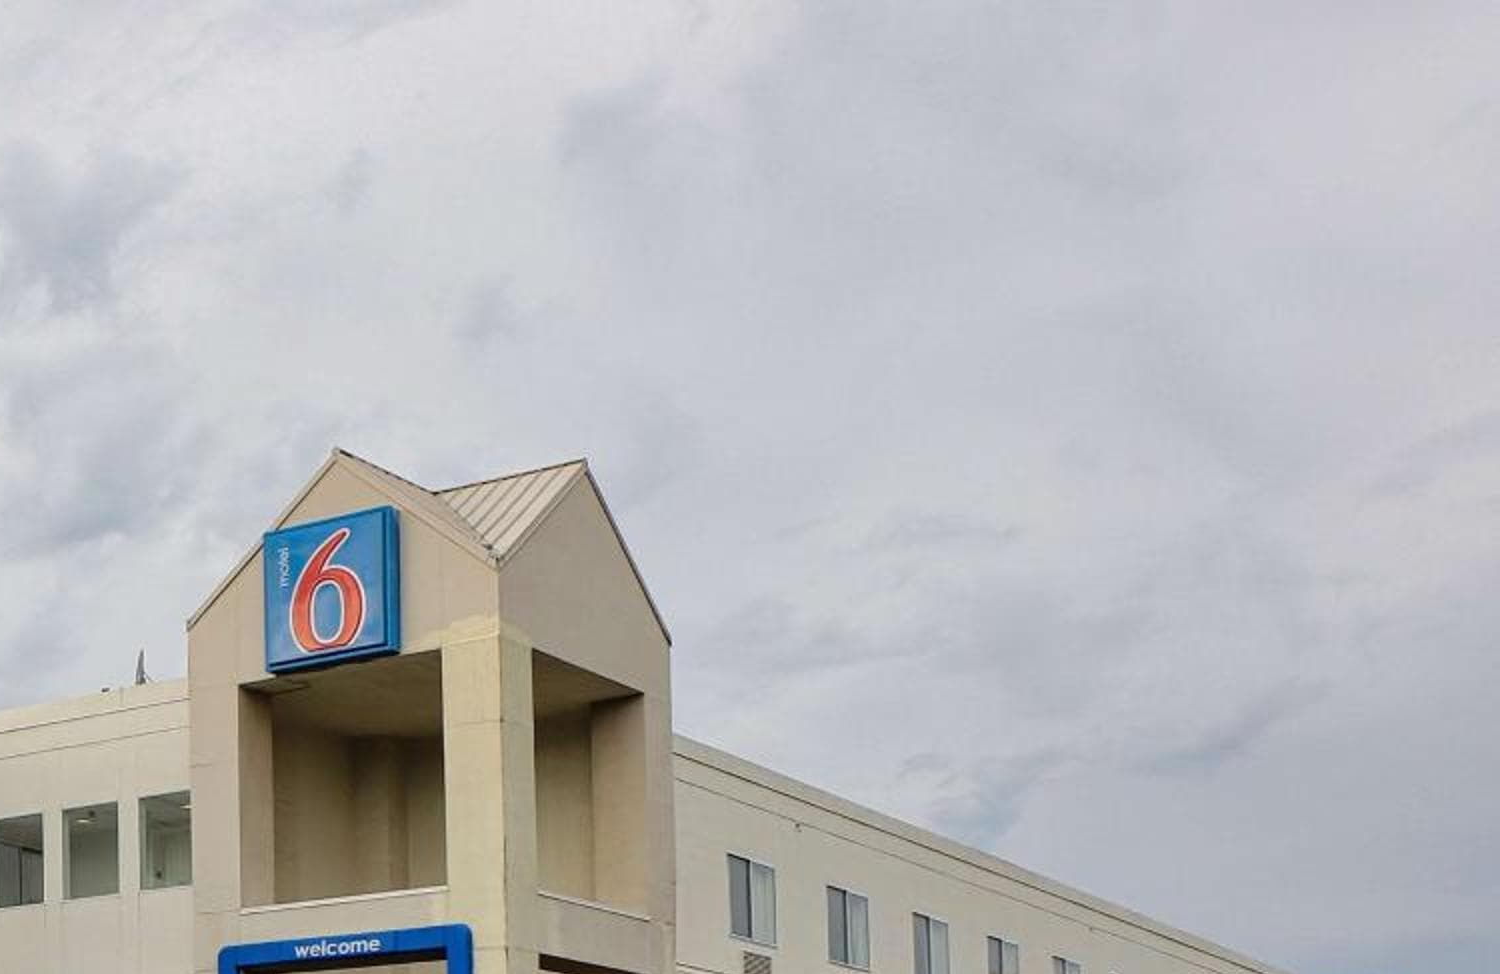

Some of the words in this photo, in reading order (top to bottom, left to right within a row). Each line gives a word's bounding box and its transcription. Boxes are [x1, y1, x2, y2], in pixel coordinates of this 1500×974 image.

[277, 546, 289, 589] motel
[289, 527, 367, 655] 6
[293, 938, 381, 959] welcome
